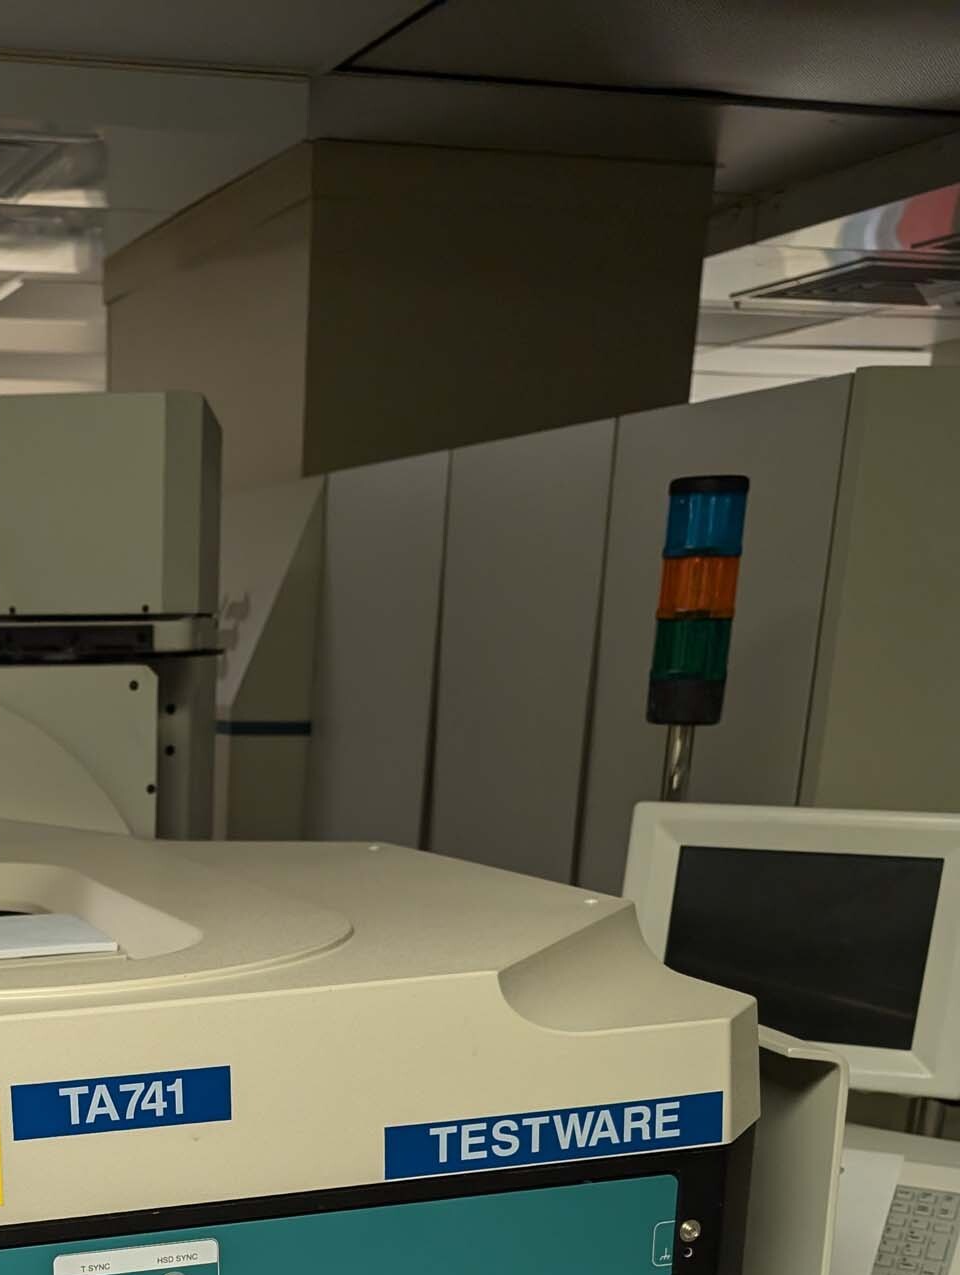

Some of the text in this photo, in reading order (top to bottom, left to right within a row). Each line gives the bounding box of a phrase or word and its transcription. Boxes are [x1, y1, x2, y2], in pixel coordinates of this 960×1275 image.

[58, 1078, 186, 1126] TA741
[429, 1101, 681, 1163] TESTWARE
[80, 1263, 111, 1273] T SYNC
[157, 1253, 198, 1264] HSD SYNC
